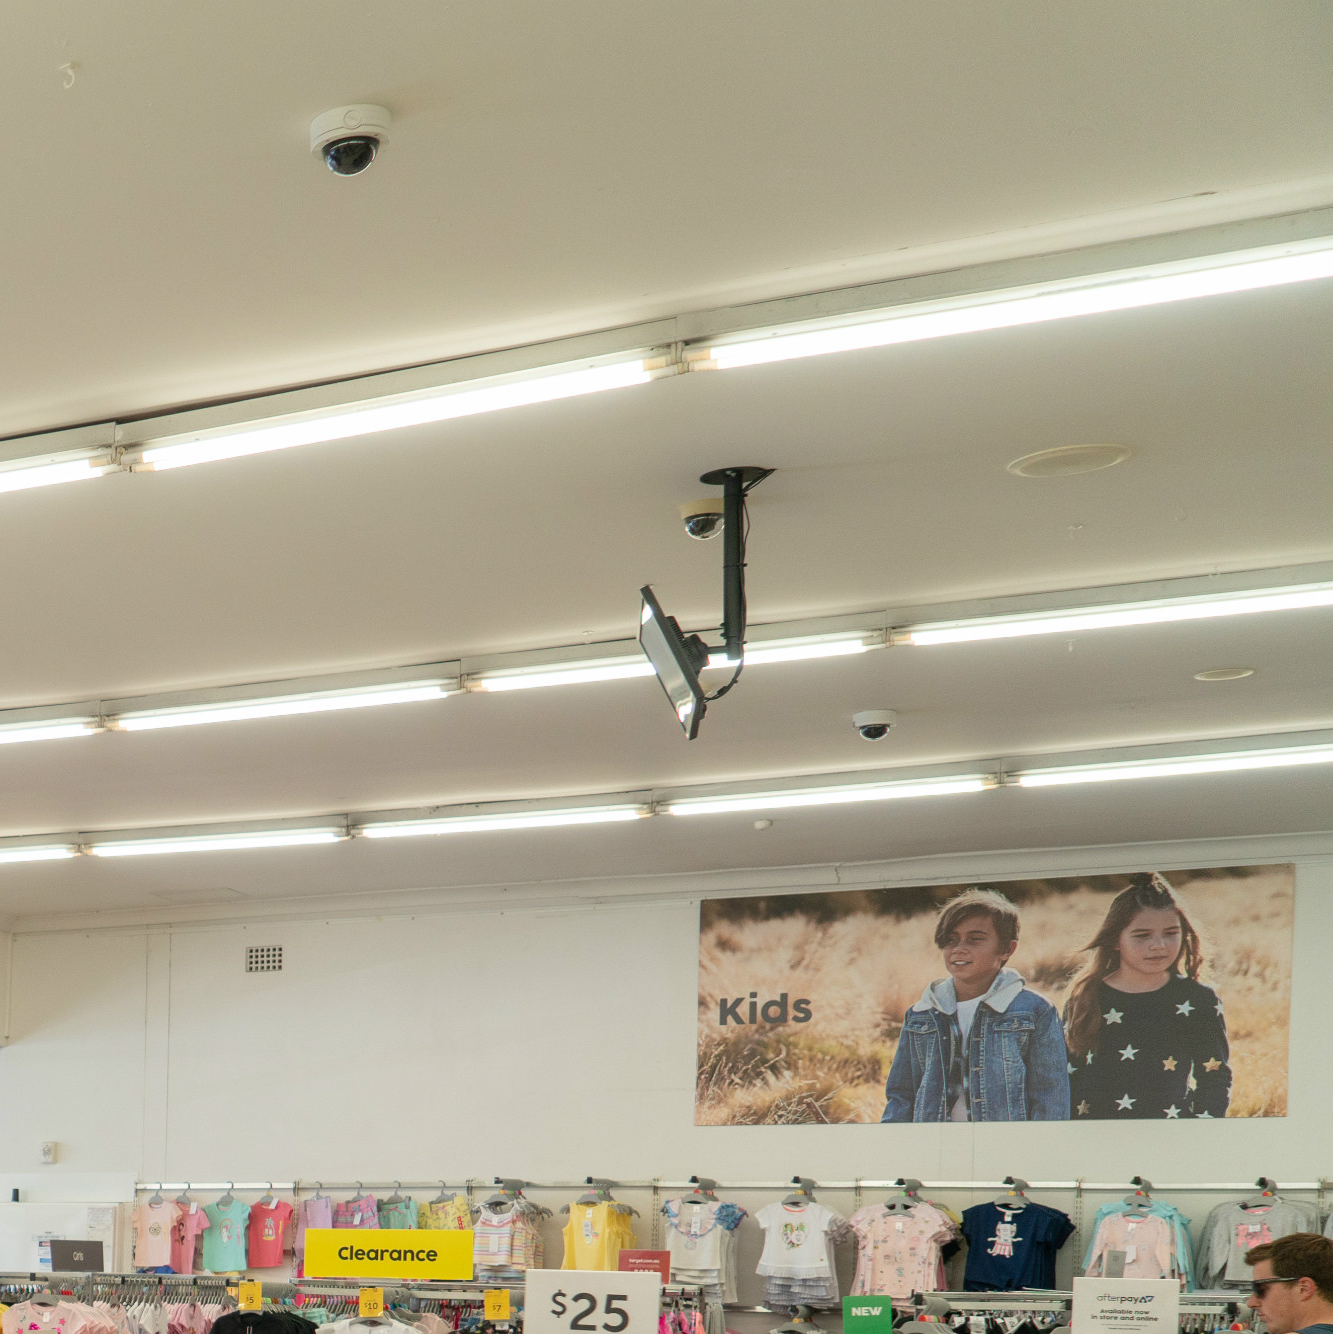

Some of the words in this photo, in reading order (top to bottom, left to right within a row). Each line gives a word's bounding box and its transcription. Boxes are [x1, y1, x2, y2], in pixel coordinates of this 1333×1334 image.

[719, 991, 813, 1025] Kids
[338, 1243, 438, 1264] Clearance
[246, 1296, 254, 1304] $5
[1096, 1293, 1140, 1304] afterpay
[364, 1302, 378, 1310] $10
[493, 1304, 501, 1312] $7
[551, 1289, 629, 1333] $25
[851, 1306, 882, 1316] NEW
